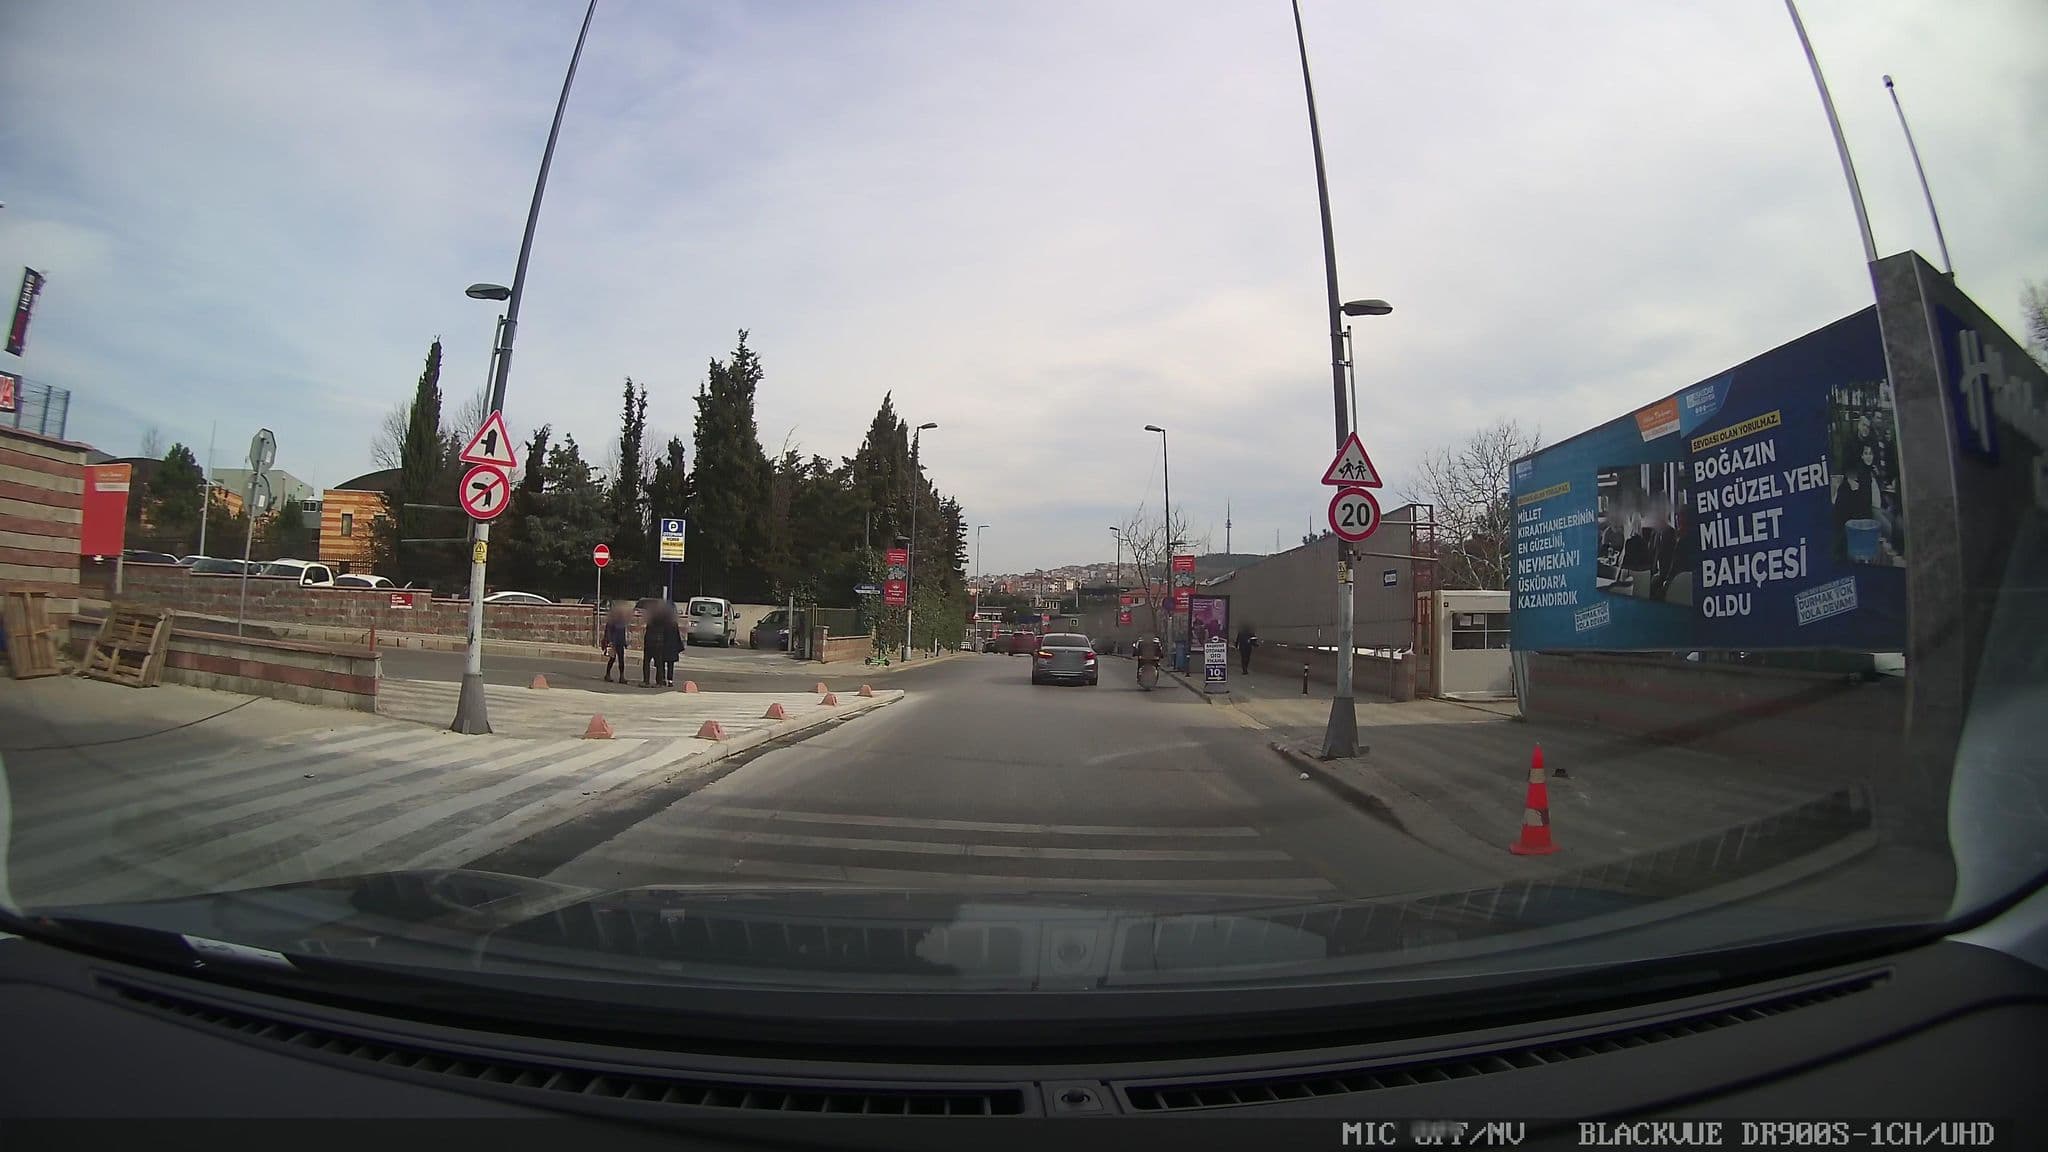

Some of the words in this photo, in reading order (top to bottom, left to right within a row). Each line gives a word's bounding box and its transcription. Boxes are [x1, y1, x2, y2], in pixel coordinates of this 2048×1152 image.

[1720, 429, 1738, 441] OLAN
[1694, 439, 1776, 483] BOĞAZIN
[1697, 489, 1719, 514] EN
[1721, 474, 1783, 508] GÜZEL
[1783, 455, 1830, 495] YERİ
[1341, 503, 1370, 527] 20
[1517, 508, 1543, 524] MİLLET
[1517, 509, 1595, 539] KIRAATHANELERİNİN
[1699, 507, 1783, 551] MİLLET
[1518, 542, 1528, 554] EN
[1518, 549, 1580, 575] NEVMEKÂN'I
[1702, 537, 1807, 588] BAHÇESİ
[1518, 574, 1567, 593] ÜSKÜDAR'A
[1518, 590, 1578, 609] KAZANDIRDIK
[1702, 592, 1751, 618] OLDU
[1799, 591, 1833, 610] DURMAK
[1800, 607, 1821, 620] YOLA
[1210, 668, 1221, 677] 10
